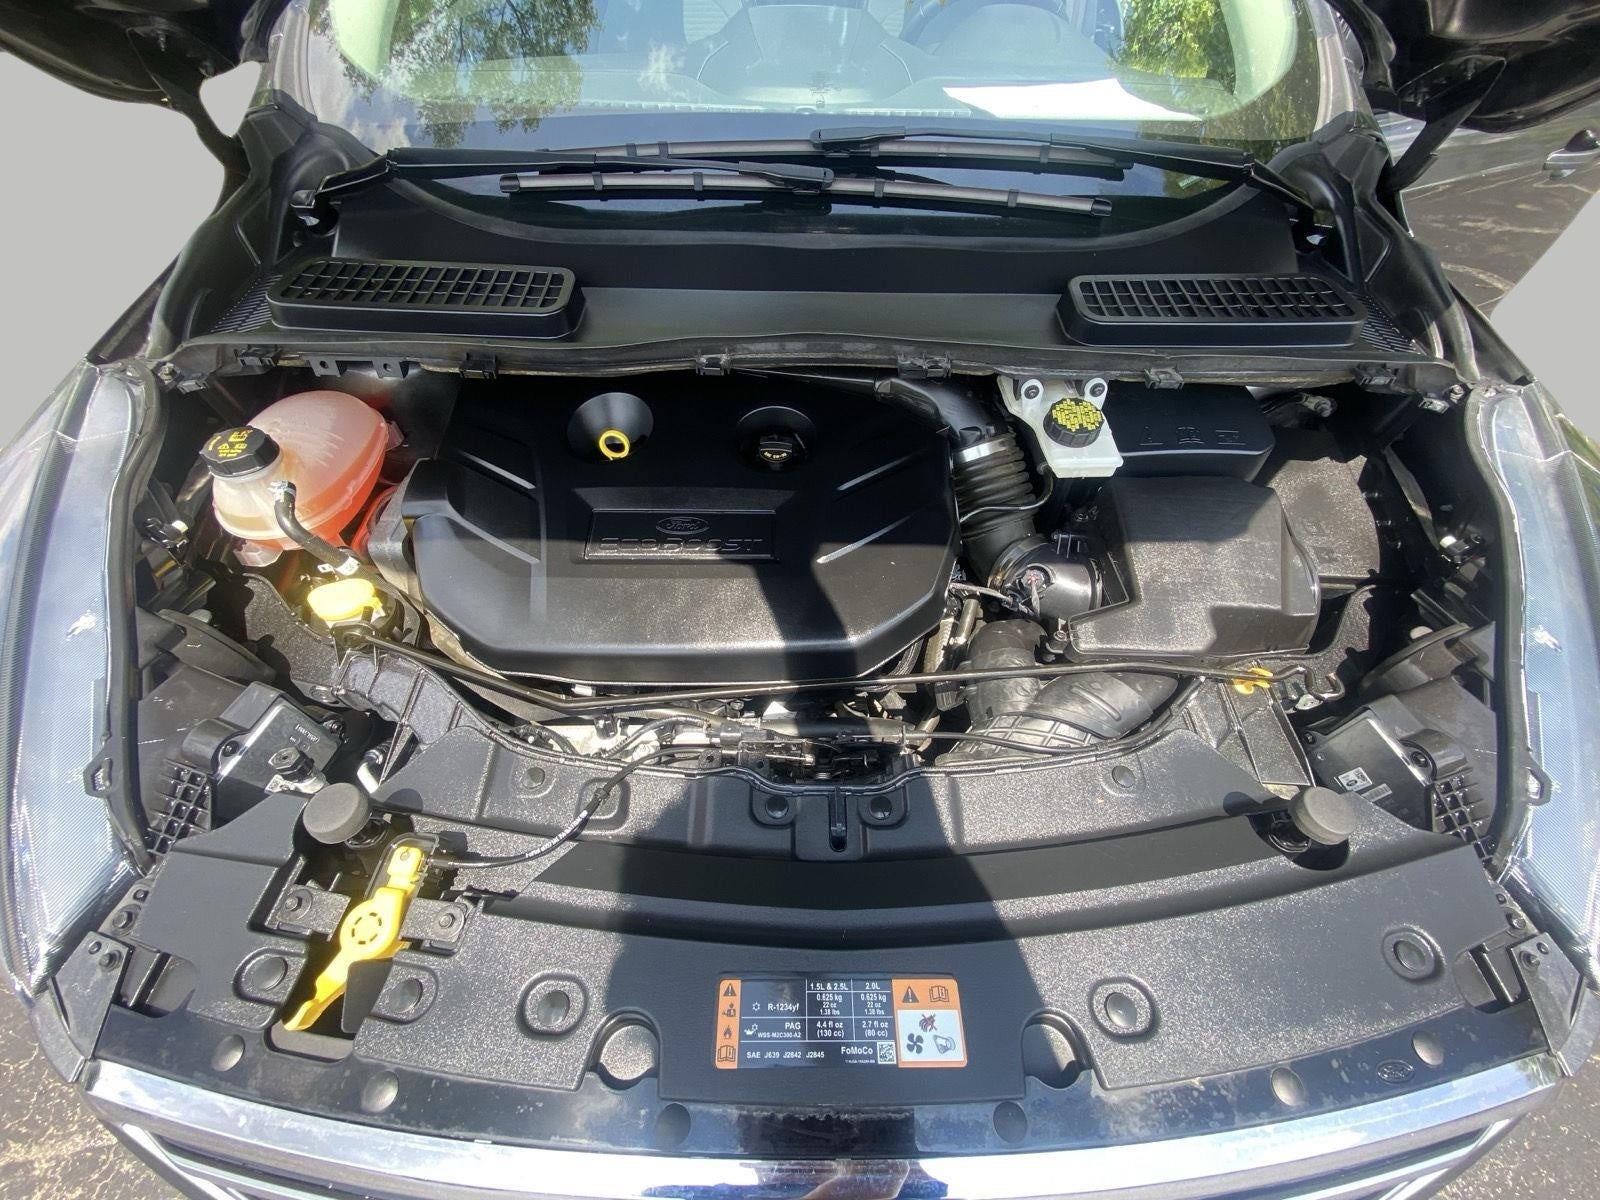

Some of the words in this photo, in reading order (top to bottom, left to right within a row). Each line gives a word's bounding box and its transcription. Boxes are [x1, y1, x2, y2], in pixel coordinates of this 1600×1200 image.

[663, 517, 702, 532] Ford
[865, 982, 880, 990] 2.0L
[816, 993, 834, 1001] 0.625
[834, 993, 842, 1002] kg
[860, 993, 877, 1001] 0.625
[878, 993, 886, 1002] kg
[767, 1003, 800, 1012] R-1234yf
[784, 1022, 801, 1030] PAG
[816, 1021, 827, 1029] 4.4
[828, 1021, 834, 1029] fl
[862, 1021, 873, 1029] 2.7
[874, 1021, 880, 1029] fl
[816, 1030, 832, 1038] (130
[833, 1030, 845, 1038] cc)
[877, 1030, 888, 1038] cc)
[841, 1046, 874, 1055] FoMoCo
